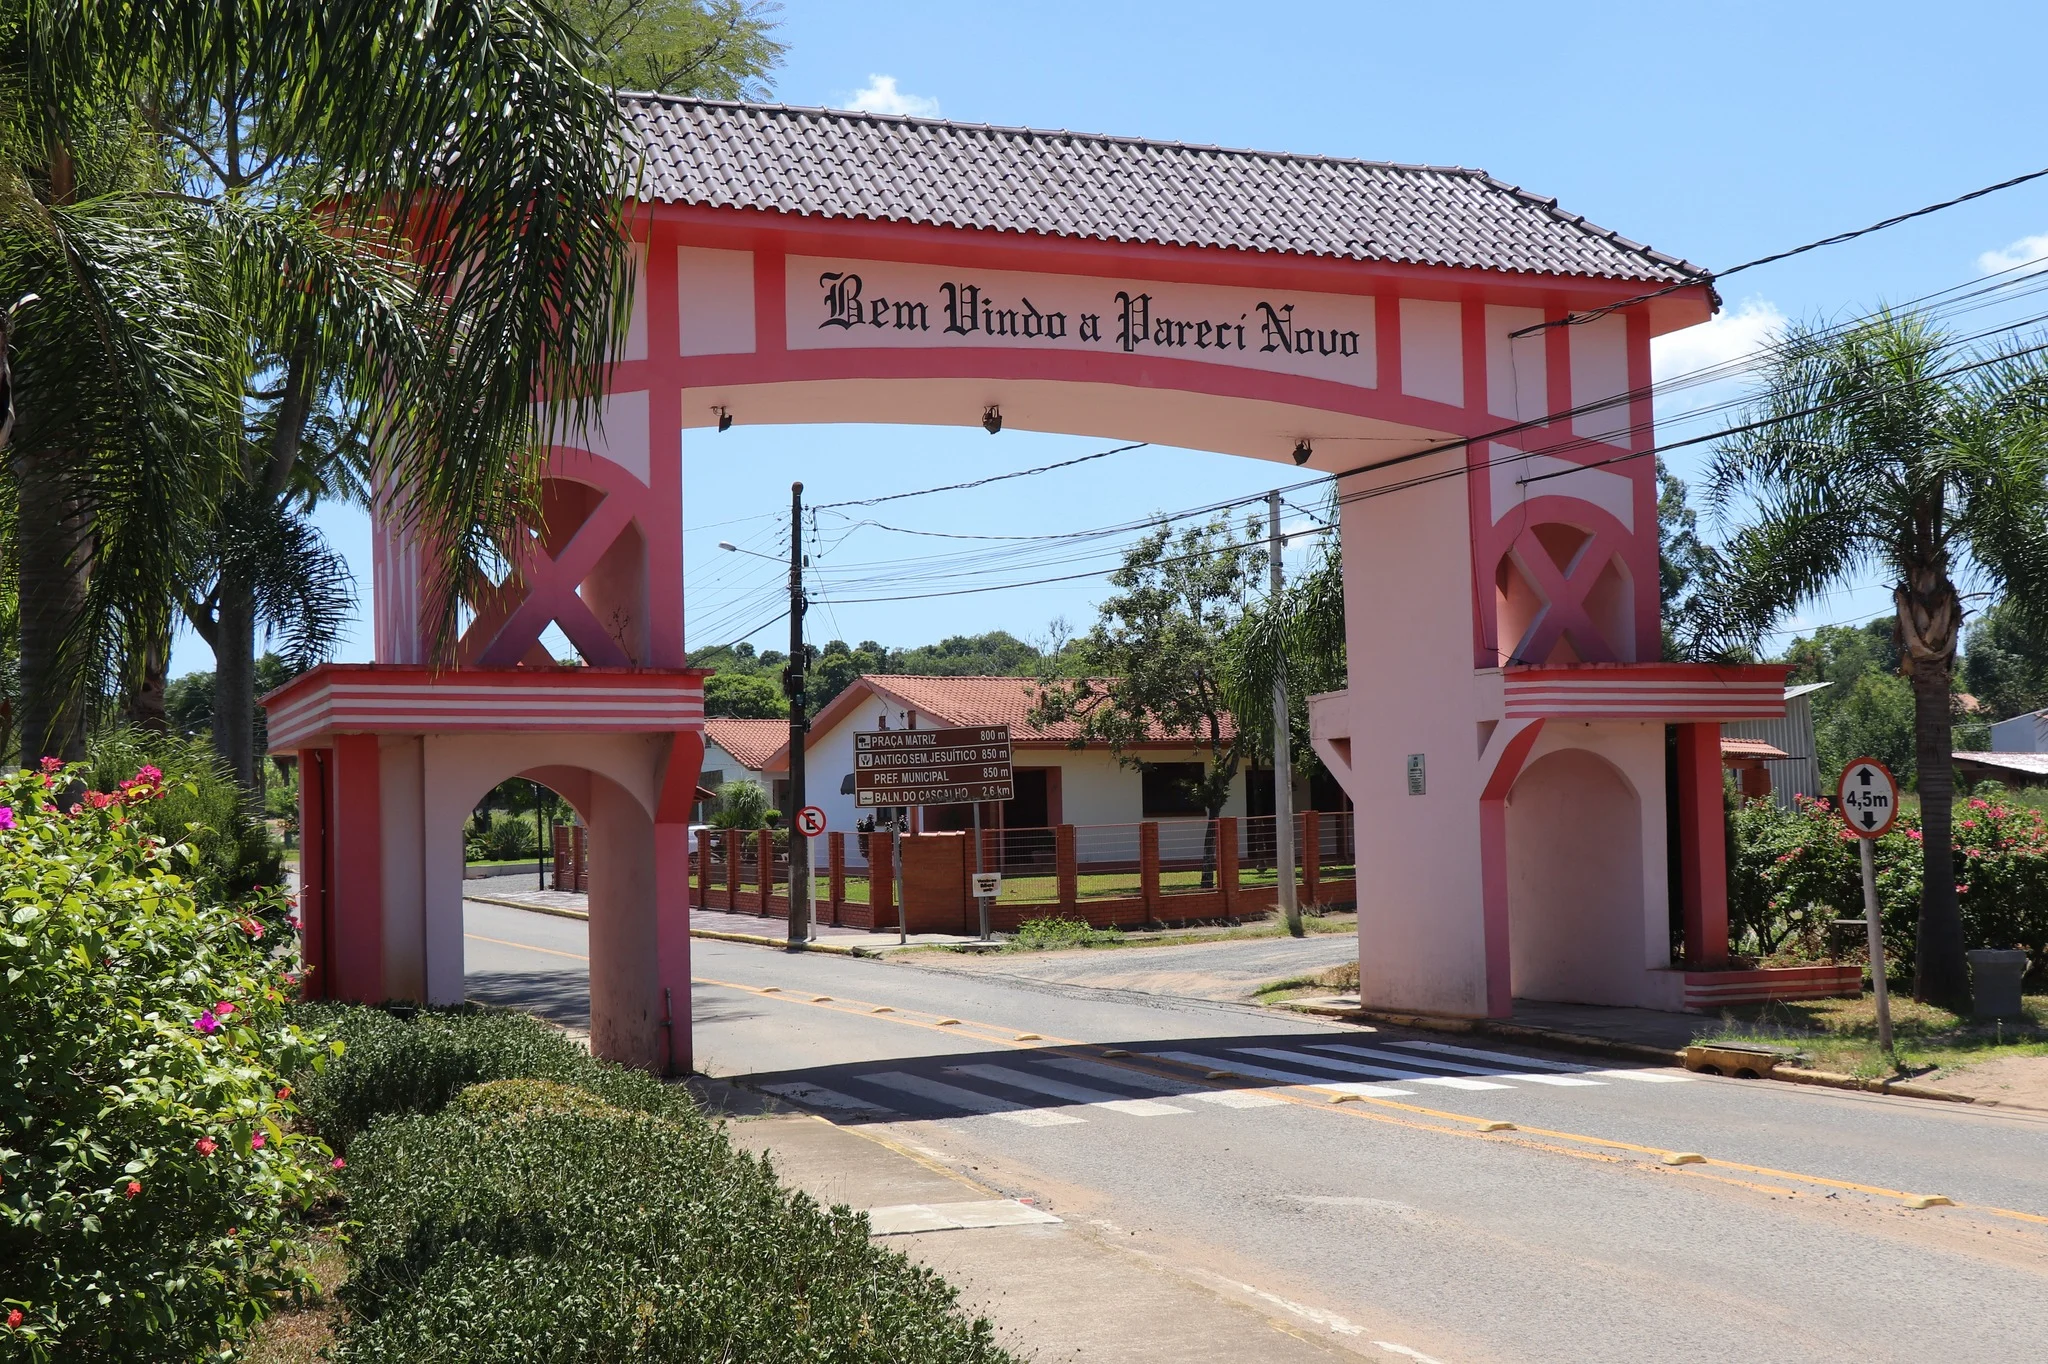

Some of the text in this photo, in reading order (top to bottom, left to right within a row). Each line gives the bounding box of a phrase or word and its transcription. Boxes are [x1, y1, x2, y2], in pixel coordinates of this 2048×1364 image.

[819, 271, 1360, 358] Bem Vindo a Pareci Novo
[872, 730, 1006, 748] PRAÇA MATRIZ 800 m
[874, 748, 1008, 766] ANTIGO SEM. JESUÍTICO 850 m
[874, 767, 1009, 785] PREF. MUNICIPAL 850 m
[875, 791, 901, 803] BALN.
[903, 790, 916, 802] DO
[997, 785, 1010, 796] km
[1846, 790, 1888, 811] 4,5m
[806, 813, 815, 830] E
